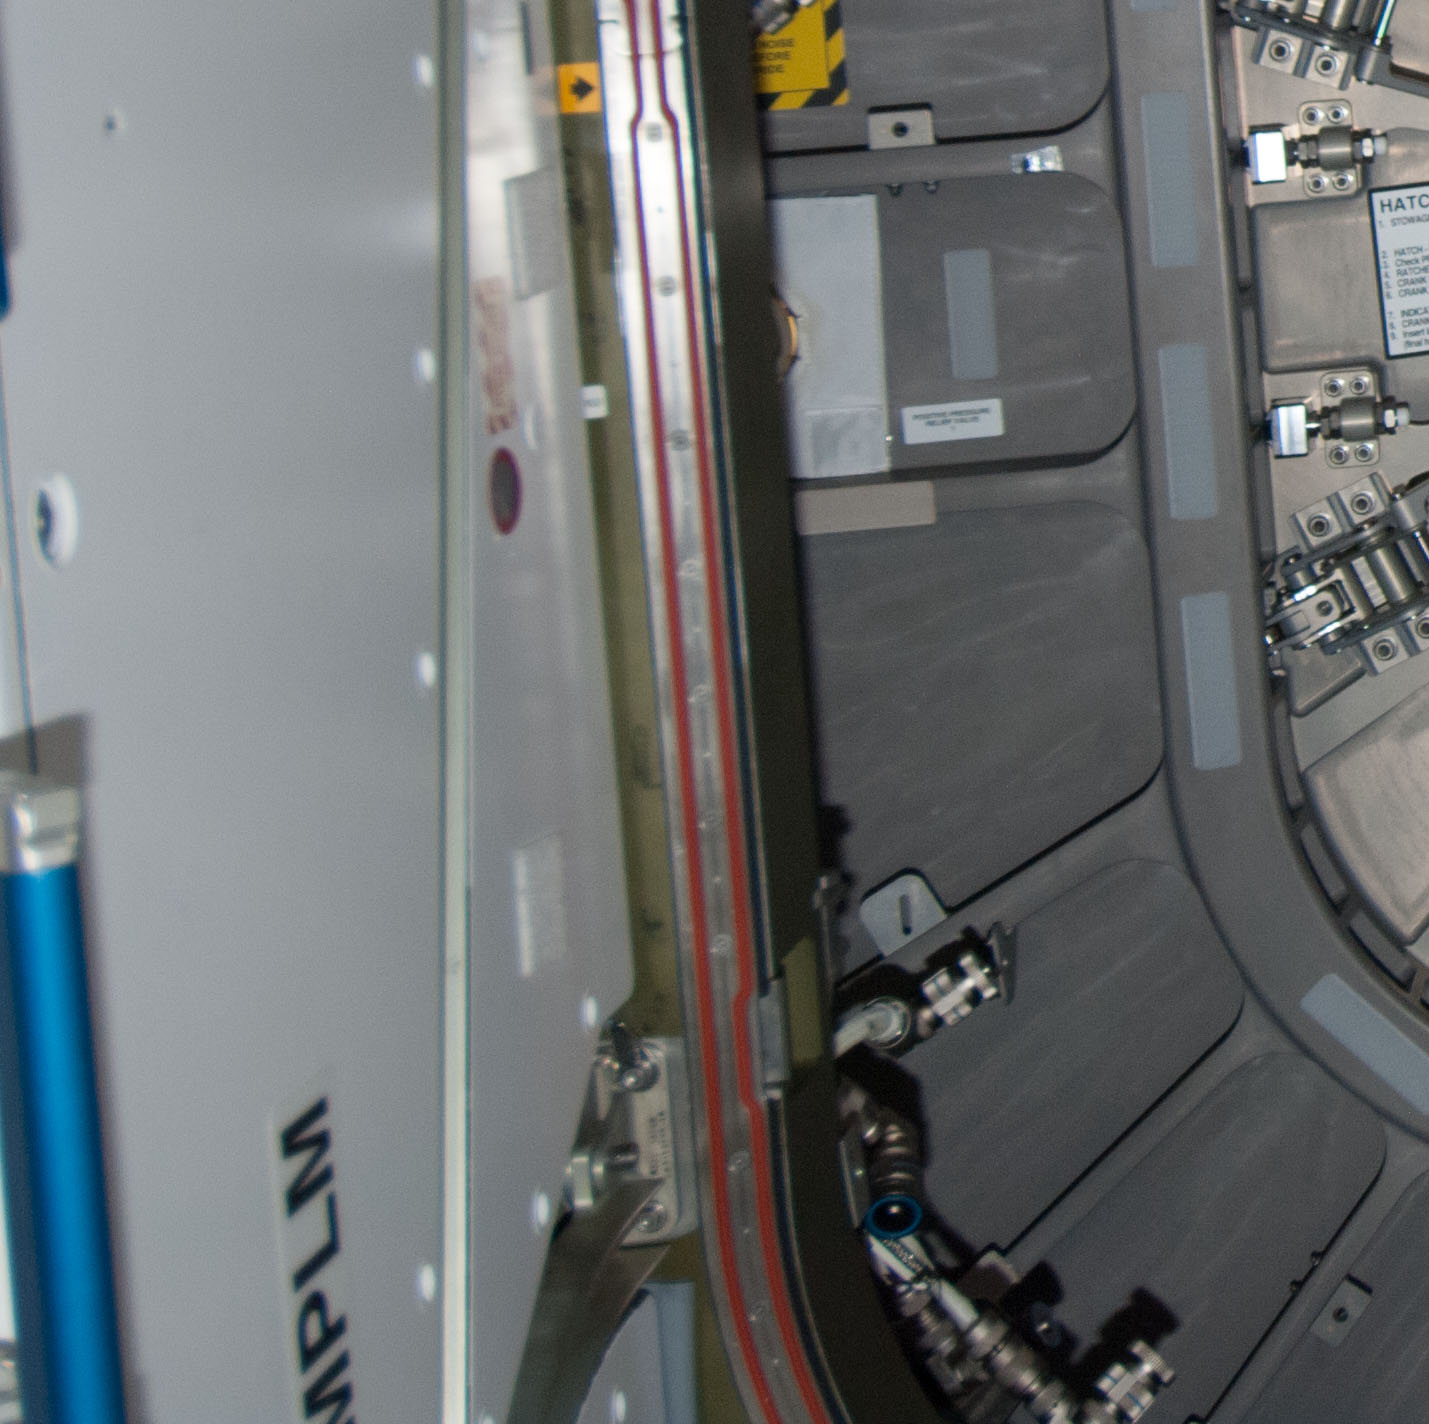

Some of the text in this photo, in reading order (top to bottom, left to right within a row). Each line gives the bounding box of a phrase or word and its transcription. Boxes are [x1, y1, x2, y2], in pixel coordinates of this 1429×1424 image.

[1394, 246, 1423, 256] HATCH
[1397, 277, 1426, 287] CRANK
[1398, 287, 1428, 298] CRANK
[280, 1095, 358, 1424] MPLM
